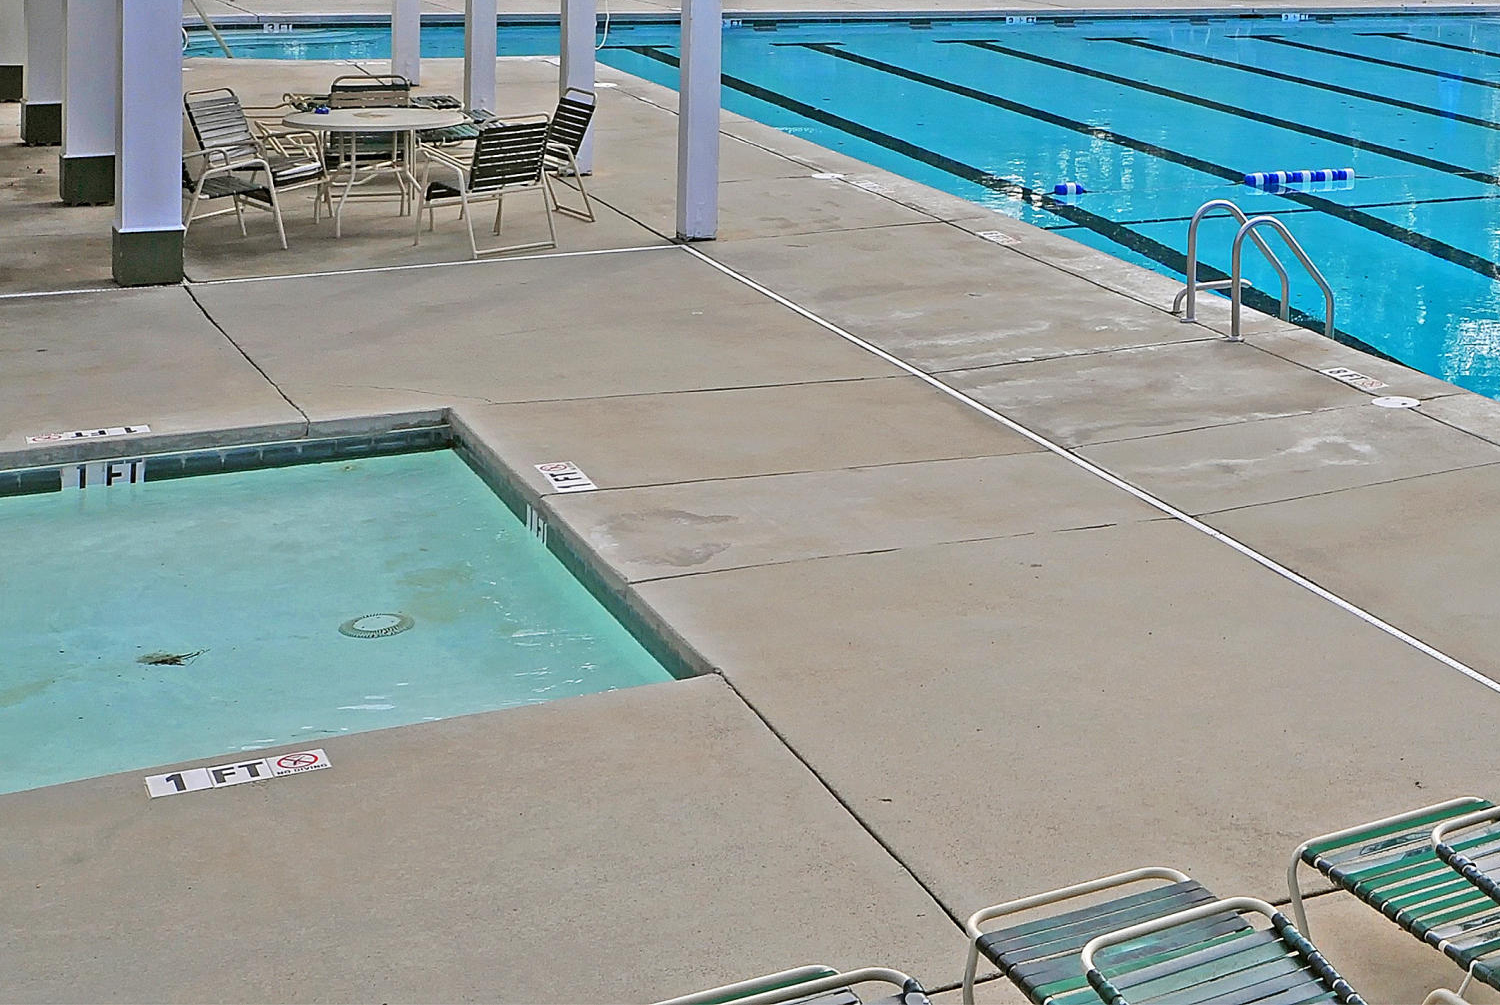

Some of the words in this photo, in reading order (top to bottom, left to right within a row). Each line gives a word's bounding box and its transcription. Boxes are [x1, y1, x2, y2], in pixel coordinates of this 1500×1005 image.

[76, 463, 87, 489] 1
[106, 459, 143, 487] FT
[165, 773, 187, 792] 1
[212, 761, 264, 784] FT
[294, 763, 328, 772] DIVING
